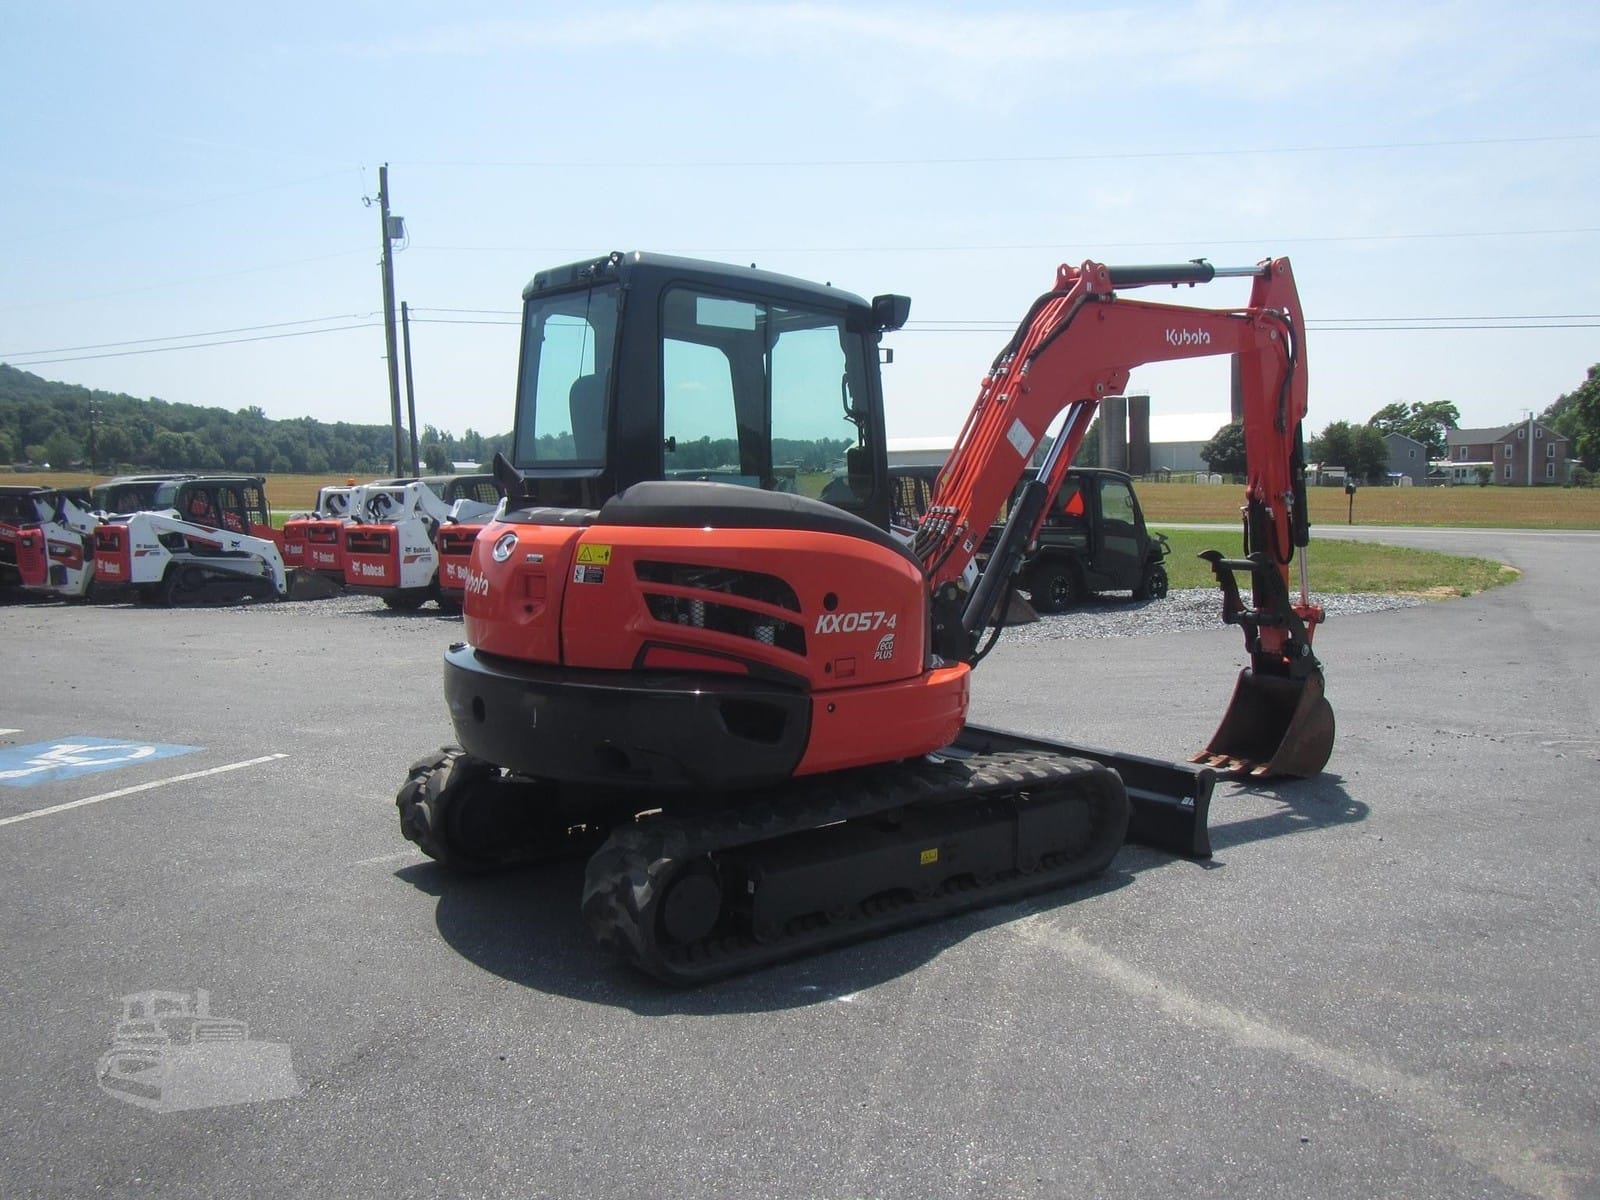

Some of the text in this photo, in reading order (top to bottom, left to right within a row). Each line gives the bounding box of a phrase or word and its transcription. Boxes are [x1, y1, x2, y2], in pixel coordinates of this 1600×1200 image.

[1166, 328, 1211, 346] Kubota
[362, 563, 386, 577] Bobcat
[815, 611, 897, 635] KX057-4
[880, 641, 894, 651] eco
[873, 650, 893, 660] PLUS
